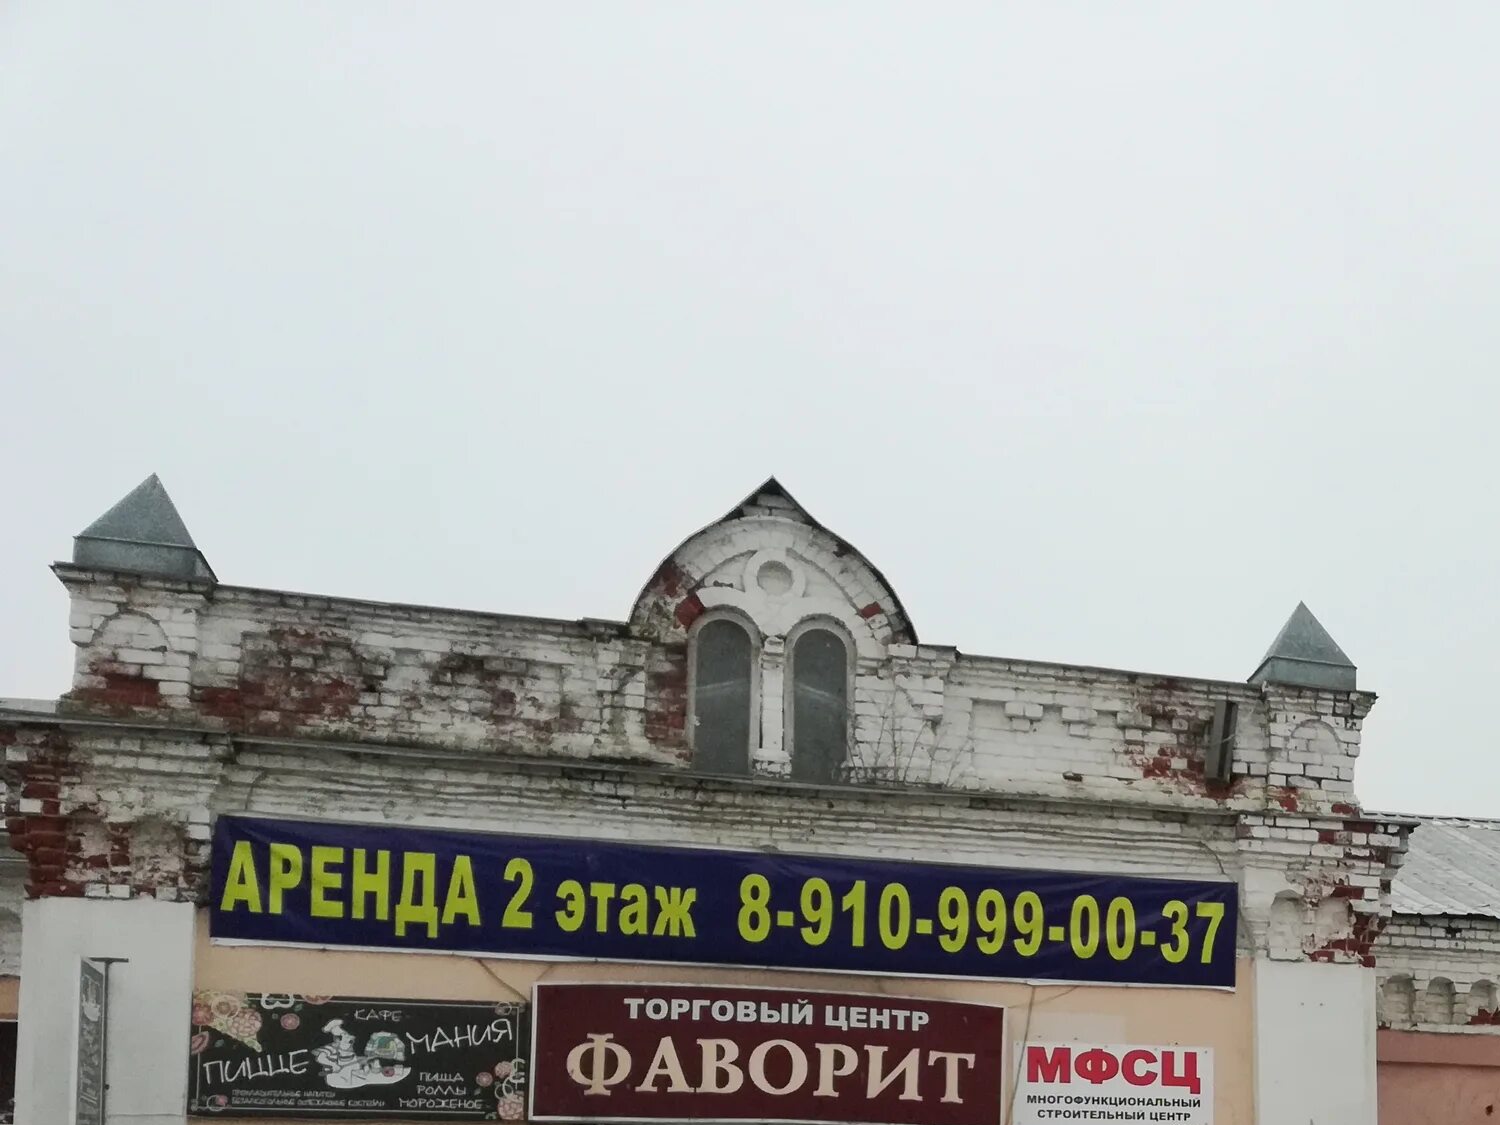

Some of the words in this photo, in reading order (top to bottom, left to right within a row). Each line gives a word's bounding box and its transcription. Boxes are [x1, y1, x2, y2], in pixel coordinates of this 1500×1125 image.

[219, 840, 481, 938] АРЕНДА
[502, 857, 534, 929] 2
[555, 879, 697, 937] этаж
[738, 873, 1225, 964] 8-910-999-00-37
[354, 1008, 403, 1022] КАФЕ
[624, 998, 813, 1026] ТОРГОВЫЙ
[825, 1004, 930, 1031] ЦЕНТР
[405, 1019, 514, 1054] МАНИЯ
[203, 1048, 309, 1085] ПИЦЦЕ
[565, 1033, 977, 1104] ФАВОРИТ
[1027, 1046, 1201, 1095] МФСЦ
[398, 1097, 484, 1109] МОРОЖЕНОЕ
[416, 1084, 467, 1096] РОЛЛЫ
[1027, 1094, 1201, 1108] МНОГОФУНКЦИОНАЛЬНЫЙ
[1037, 1109, 1145, 1121] СТРОИТЕЛЬНЫЙ
[1149, 1112, 1191, 1122] ЦЕНТР
